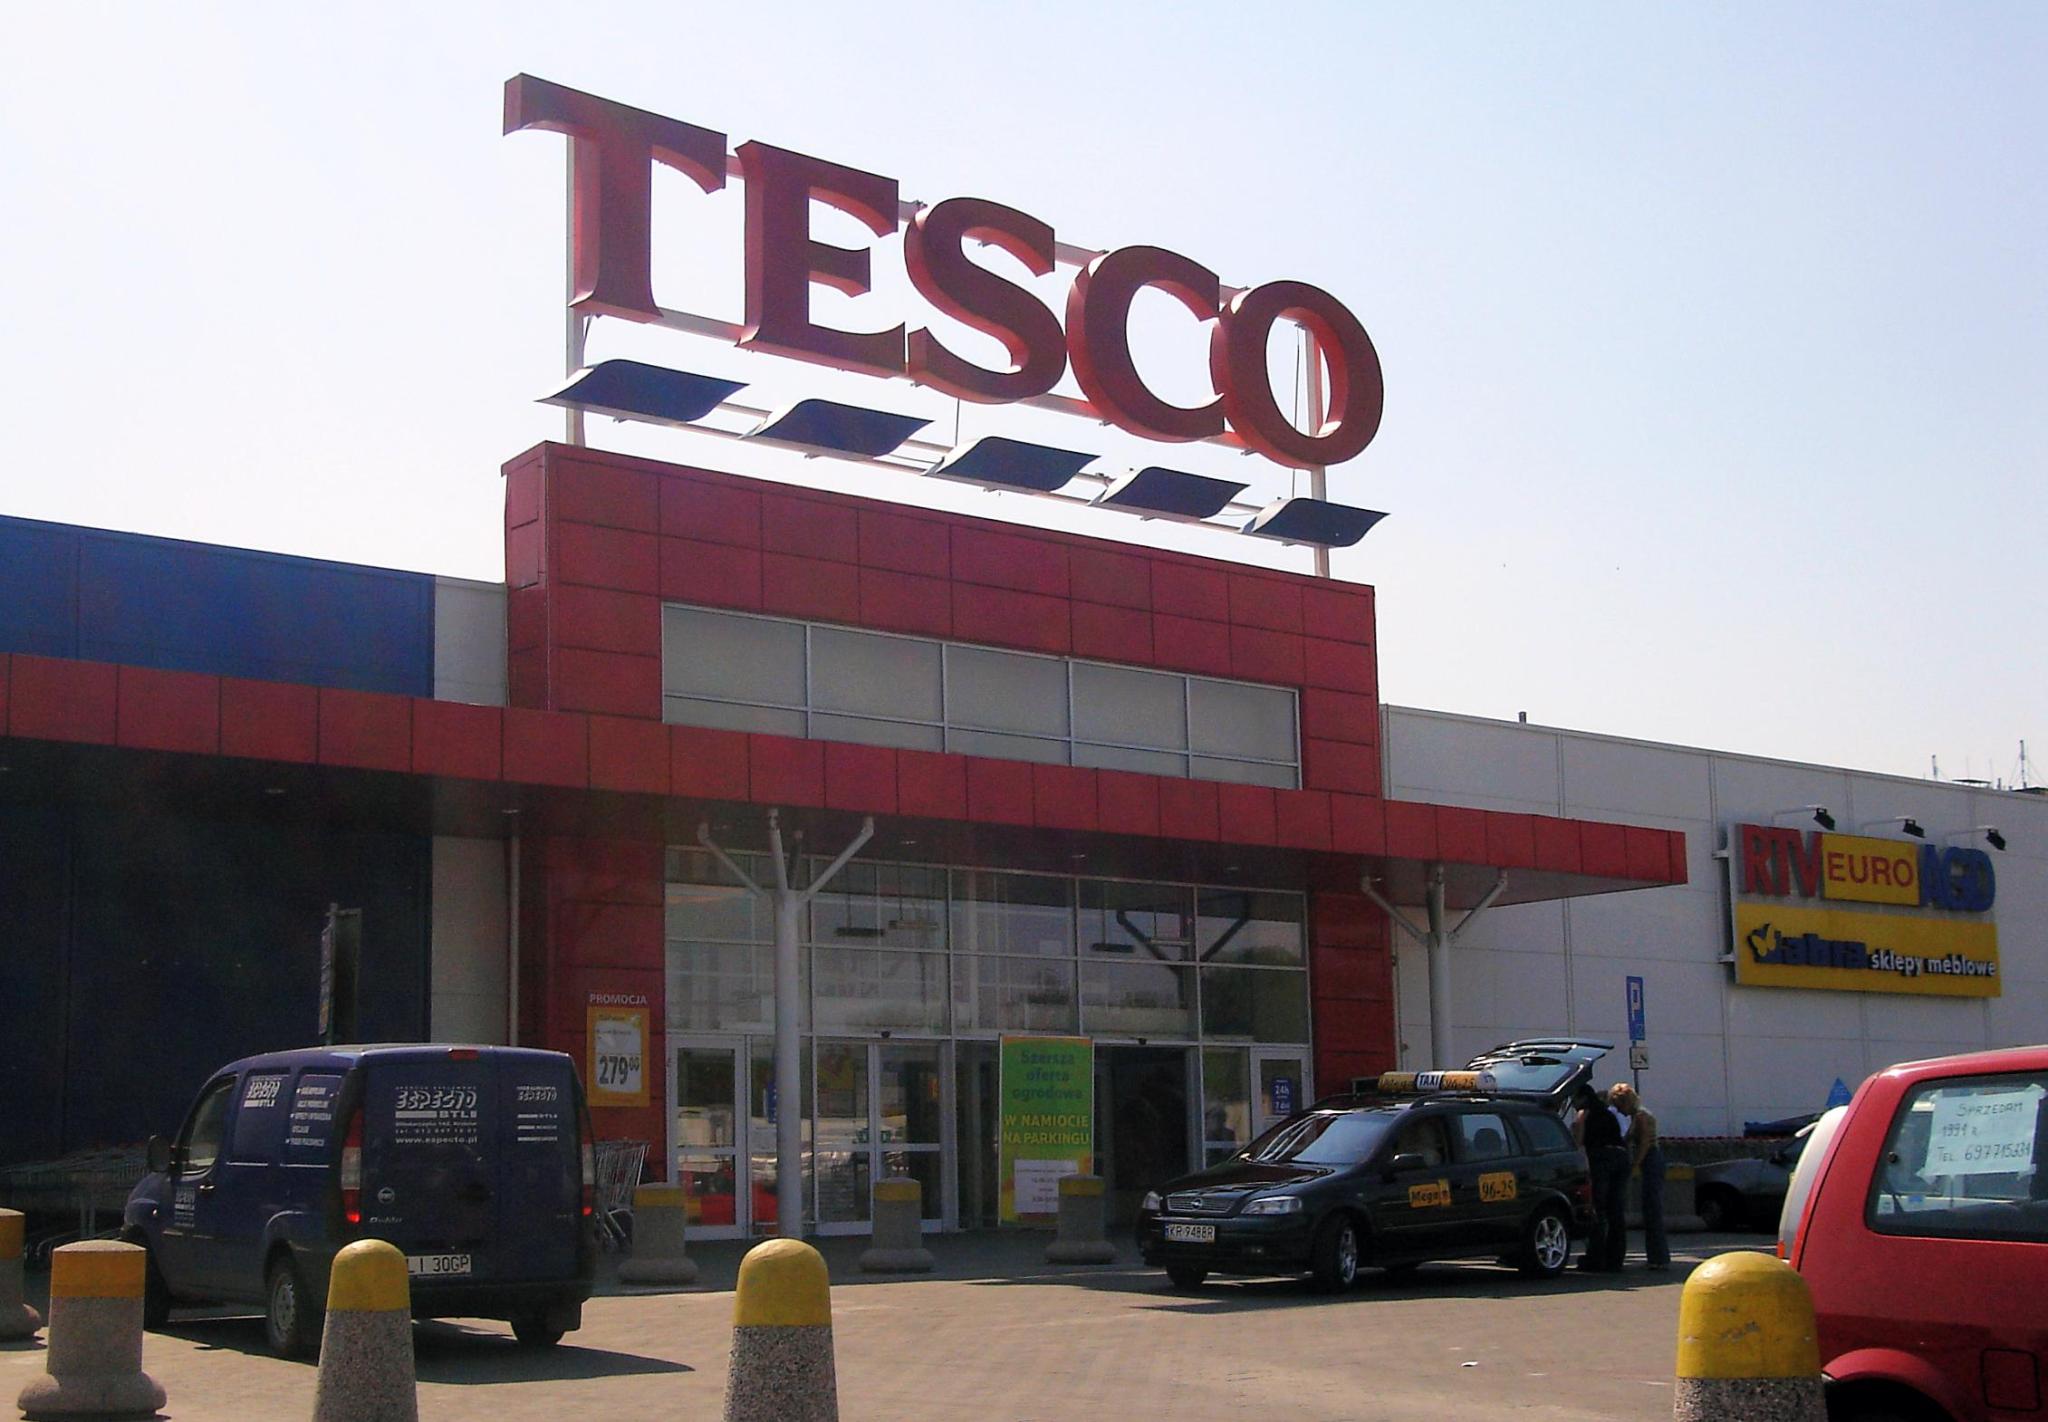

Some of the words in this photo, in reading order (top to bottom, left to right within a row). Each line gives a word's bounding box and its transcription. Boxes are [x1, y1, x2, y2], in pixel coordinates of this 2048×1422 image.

[503, 73, 1384, 469] TESCO
[1742, 824, 1824, 897] RTV
[1826, 852, 1914, 888] EURO
[1922, 844, 1996, 912] AGD
[1871, 949, 1923, 977] sklepy
[1926, 953, 1997, 977] meblowe
[589, 993, 648, 1005] PROMOCJA
[1026, 1066, 1070, 1082] oferta
[1418, 1073, 1441, 1089] TAXI
[1003, 1115, 1016, 1126] W
[1022, 1115, 1089, 1128] NAMIOCIE
[1003, 1132, 1021, 1145] NA
[1023, 1132, 1089, 1146] PARKINGU
[1482, 1179, 1514, 1199] 96-25
[433, 1255, 470, 1273] 30GP
